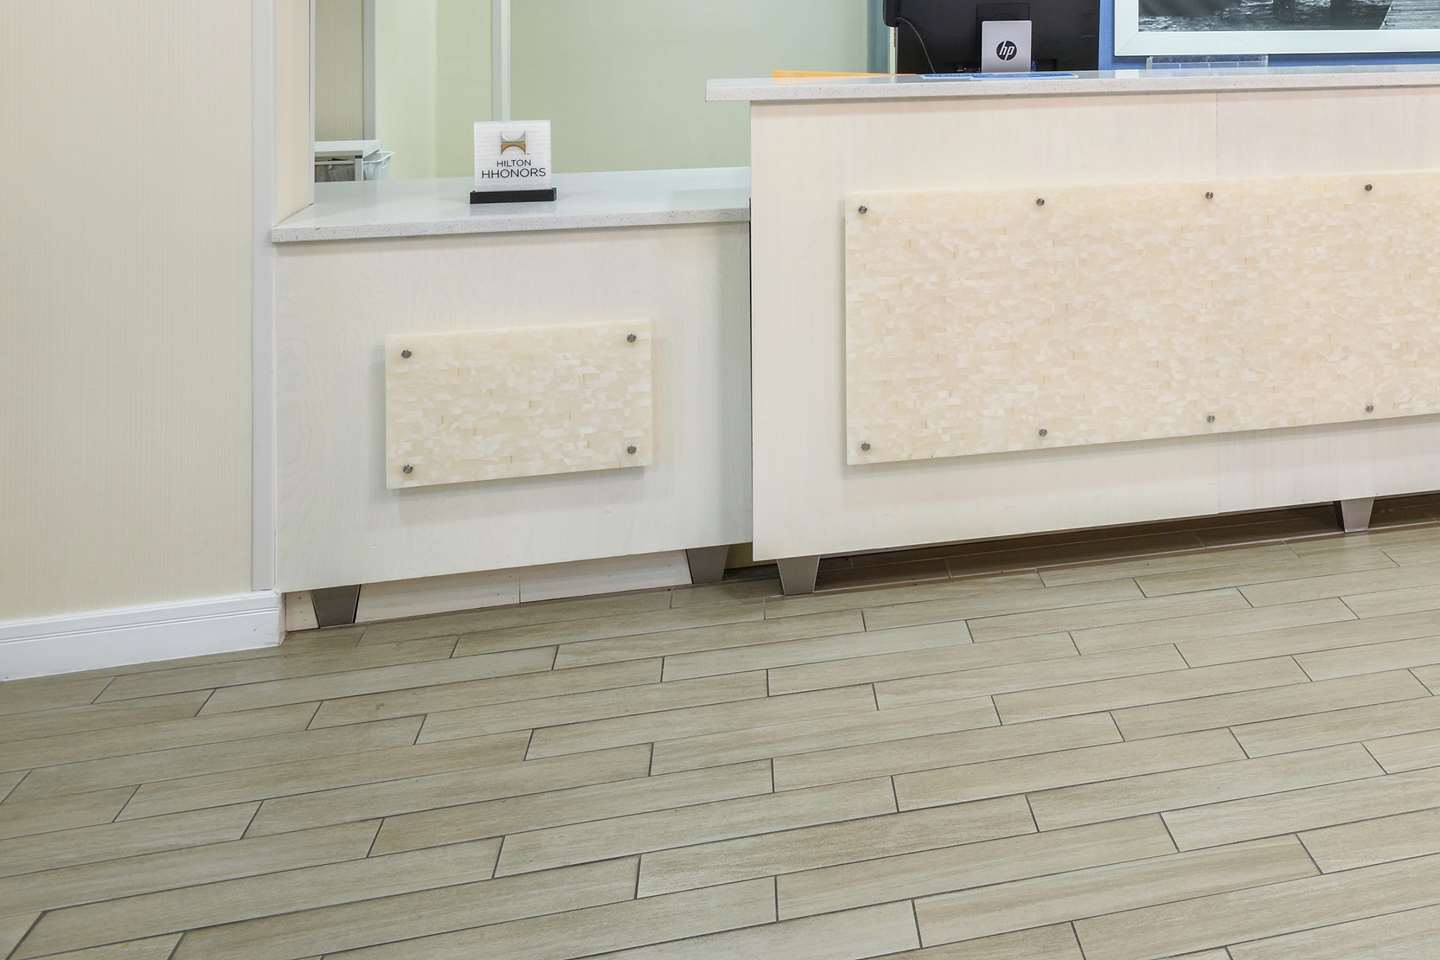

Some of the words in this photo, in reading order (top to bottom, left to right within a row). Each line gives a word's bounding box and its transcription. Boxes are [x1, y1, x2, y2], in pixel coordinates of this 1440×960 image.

[998, 40, 1017, 61] hp
[496, 159, 532, 167] HILTON
[481, 167, 546, 179] HHONORS
